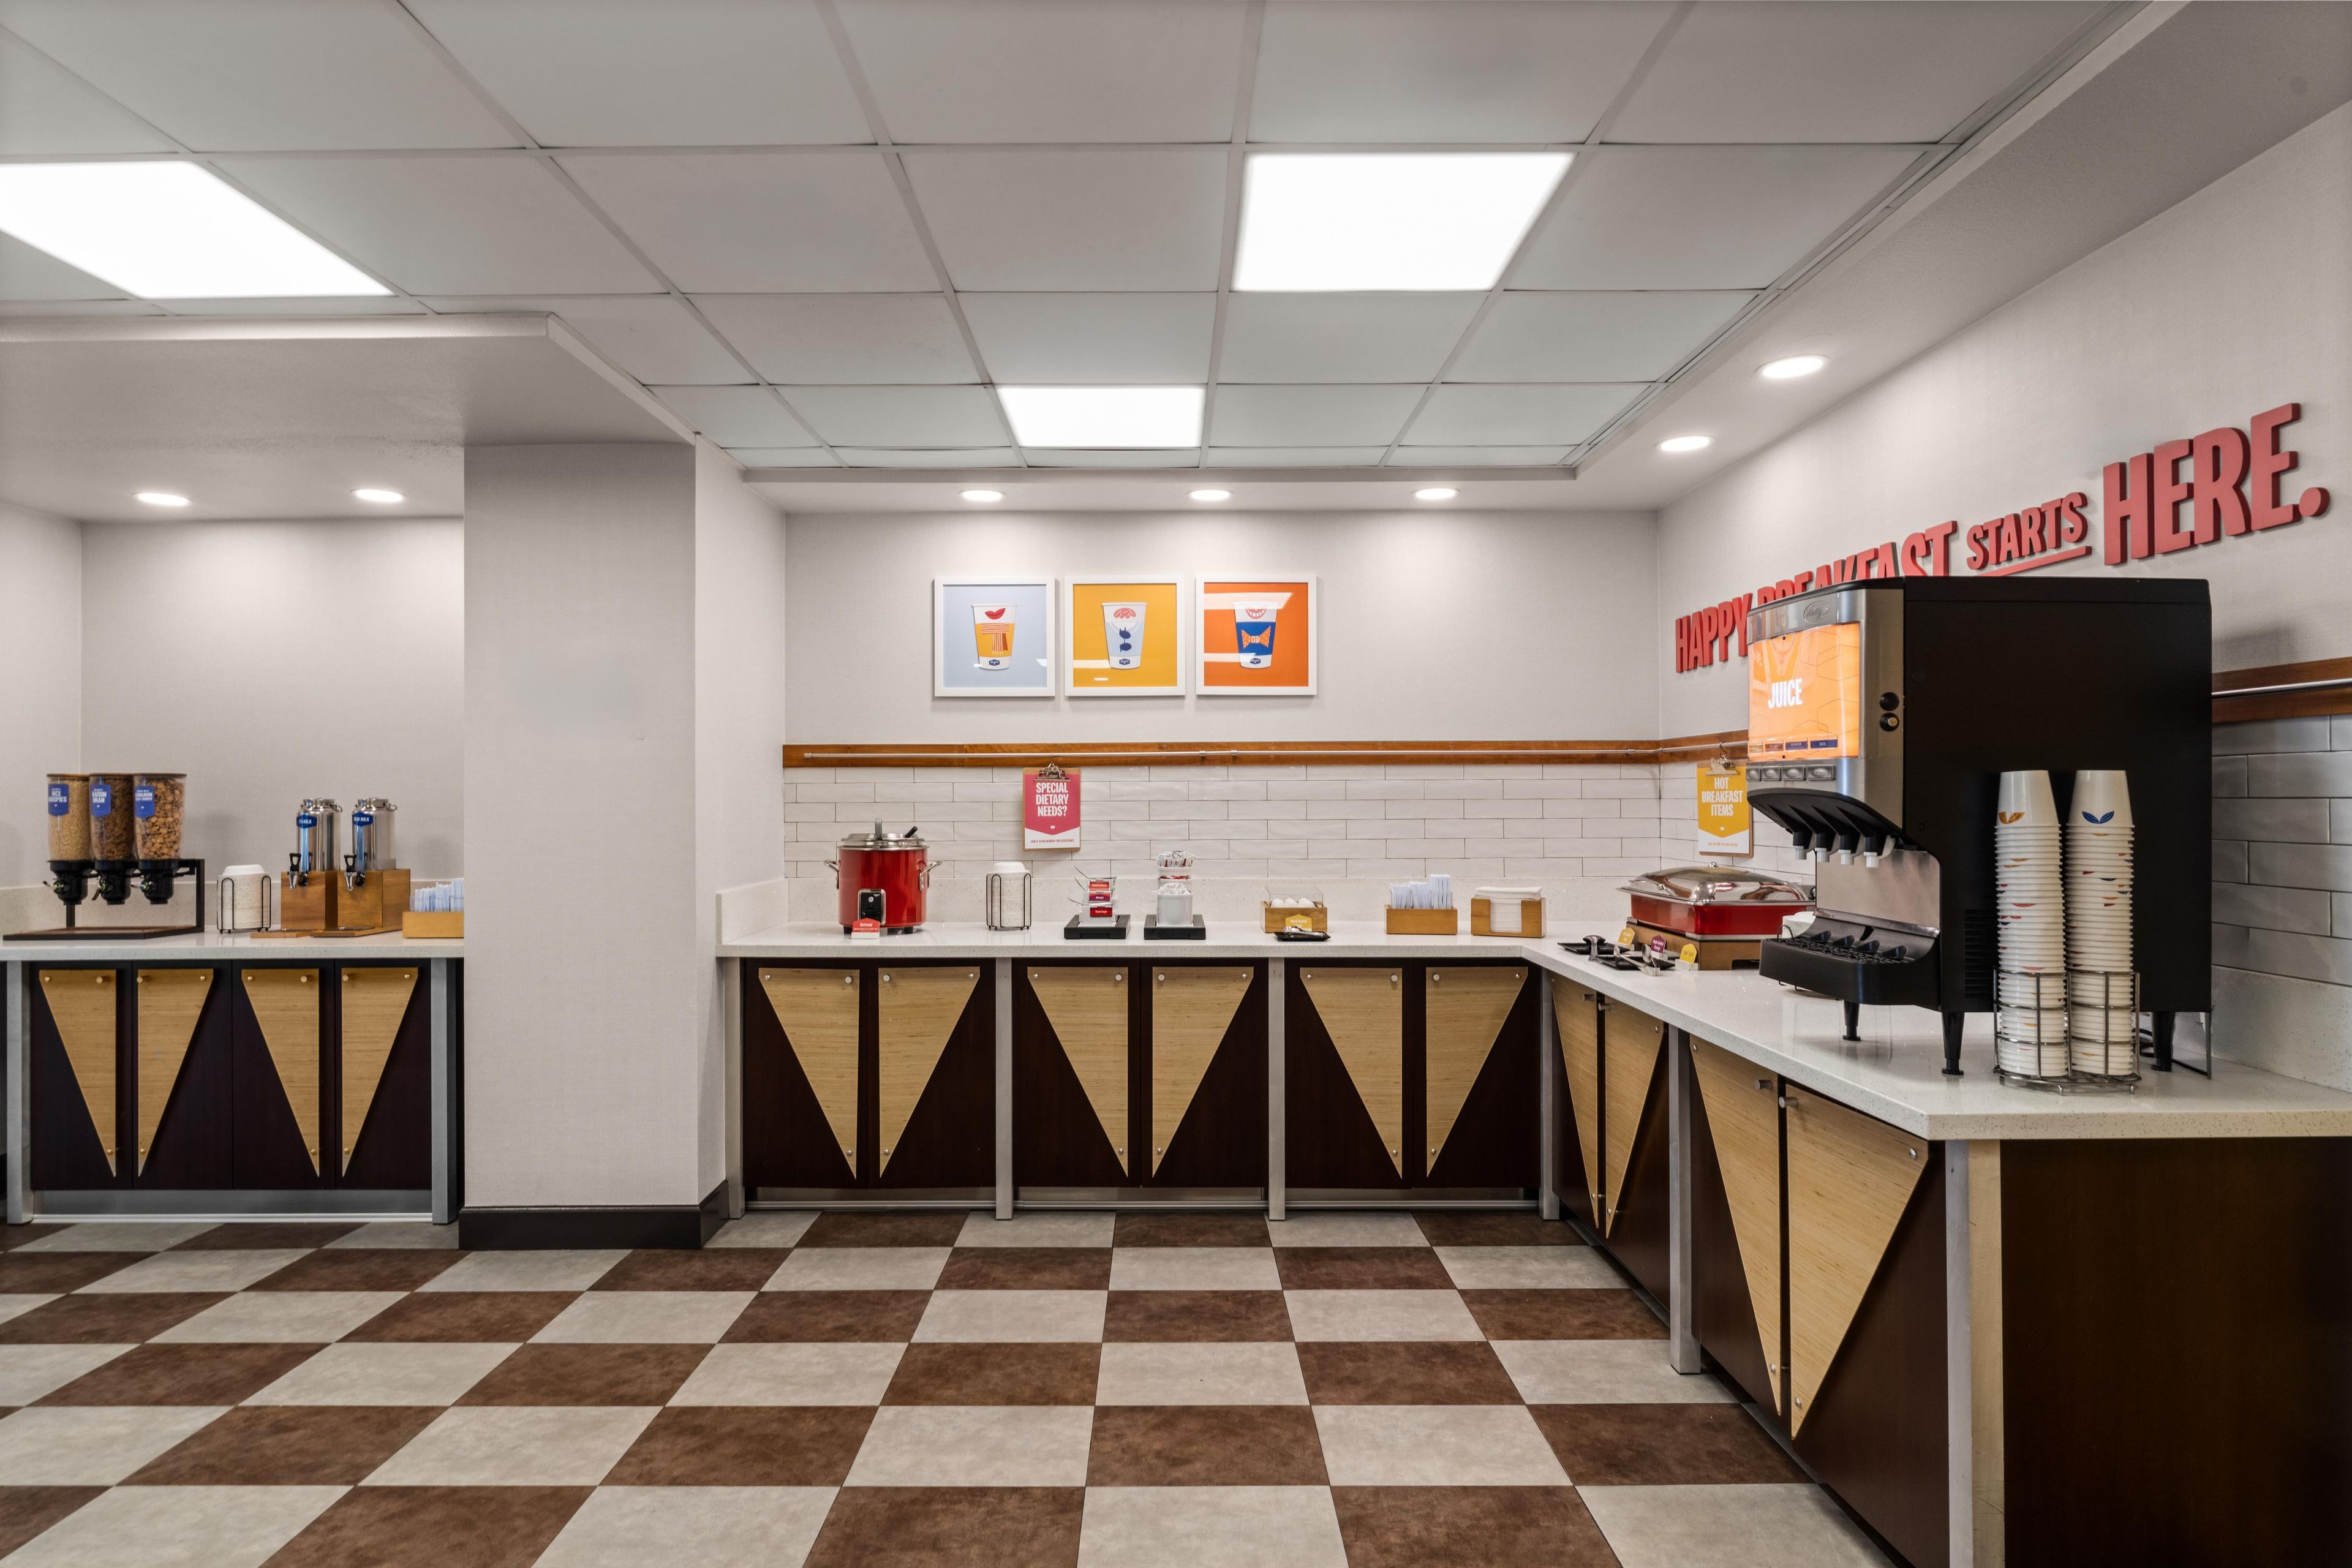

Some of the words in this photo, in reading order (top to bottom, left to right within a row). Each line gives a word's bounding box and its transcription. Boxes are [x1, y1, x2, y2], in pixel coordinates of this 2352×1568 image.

[1675, 593, 1753, 673] HAPPY
[1966, 492, 2088, 570] STARTS
[2103, 402, 2330, 566] HERE.
[1768, 678, 1803, 709] JUICE
[1036, 782, 1069, 793] SPECIAL
[1714, 777, 1730, 790] HOT
[1036, 794, 1069, 805] DIETARY
[1701, 790, 1744, 803] BREAKFAST
[1037, 805, 1068, 817] NEEDS?
[1711, 804, 1734, 816] ITEMS
